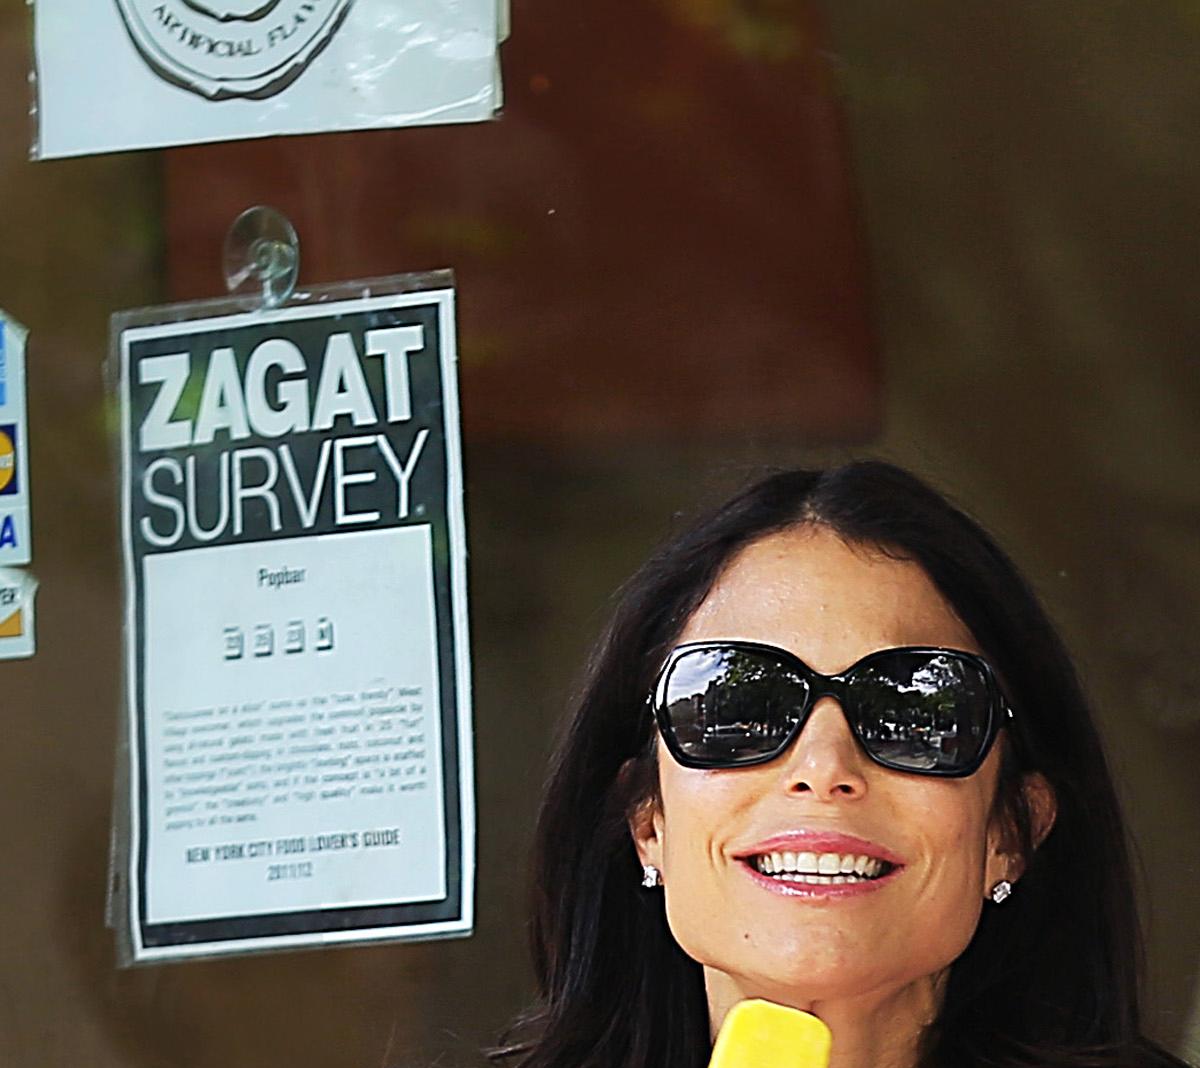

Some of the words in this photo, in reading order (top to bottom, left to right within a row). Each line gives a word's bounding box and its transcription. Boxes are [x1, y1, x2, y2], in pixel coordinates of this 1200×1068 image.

[139, 324, 424, 451] ZAGAT
[140, 429, 430, 546] SURVEY
[258, 566, 306, 589] Popbar
[187, 847, 209, 863] NEW
[214, 844, 244, 861] YORK
[249, 842, 272, 858] CITY
[277, 837, 305, 855] FOOD
[309, 831, 359, 852] LOVER'S
[362, 829, 400, 848] GUIDE
